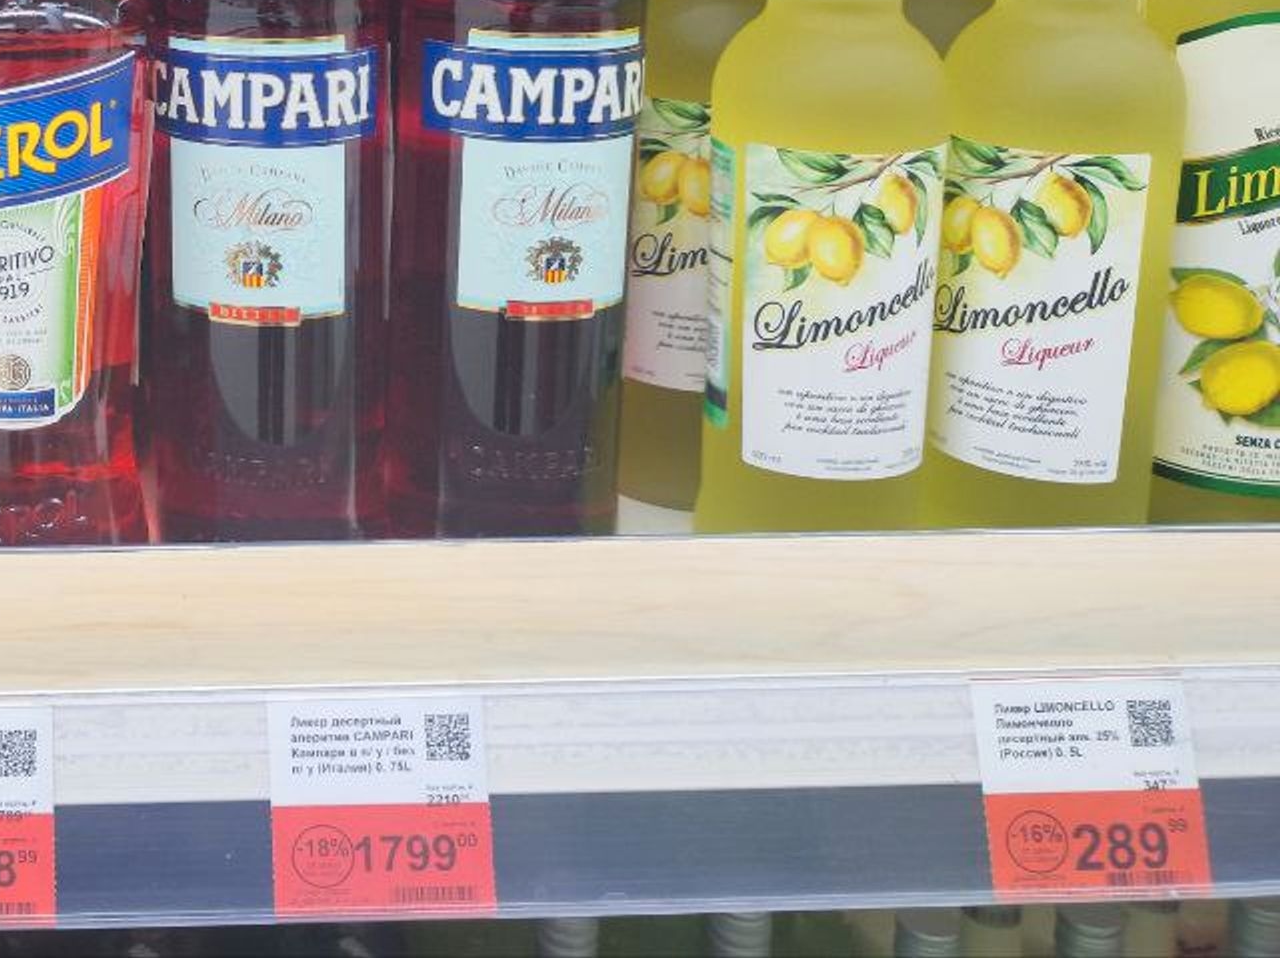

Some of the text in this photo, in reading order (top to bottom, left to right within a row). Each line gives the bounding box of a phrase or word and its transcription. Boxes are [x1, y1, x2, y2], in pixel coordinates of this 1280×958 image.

[154, 60, 370, 130] CAMPARI
[933, 266, 1130, 333] Limoncello
[1001, 338, 1094, 371] Liqueur
[1034, 700, 1115, 713] LIMONCELLO
[354, 730, 414, 742] CAMPARI
[17, 849, 38, 864] 99
[296, 837, 350, 859] -18%
[354, 834, 457, 872] 1799
[1011, 823, 1064, 843] -16%
[1073, 821, 1169, 871] 289
